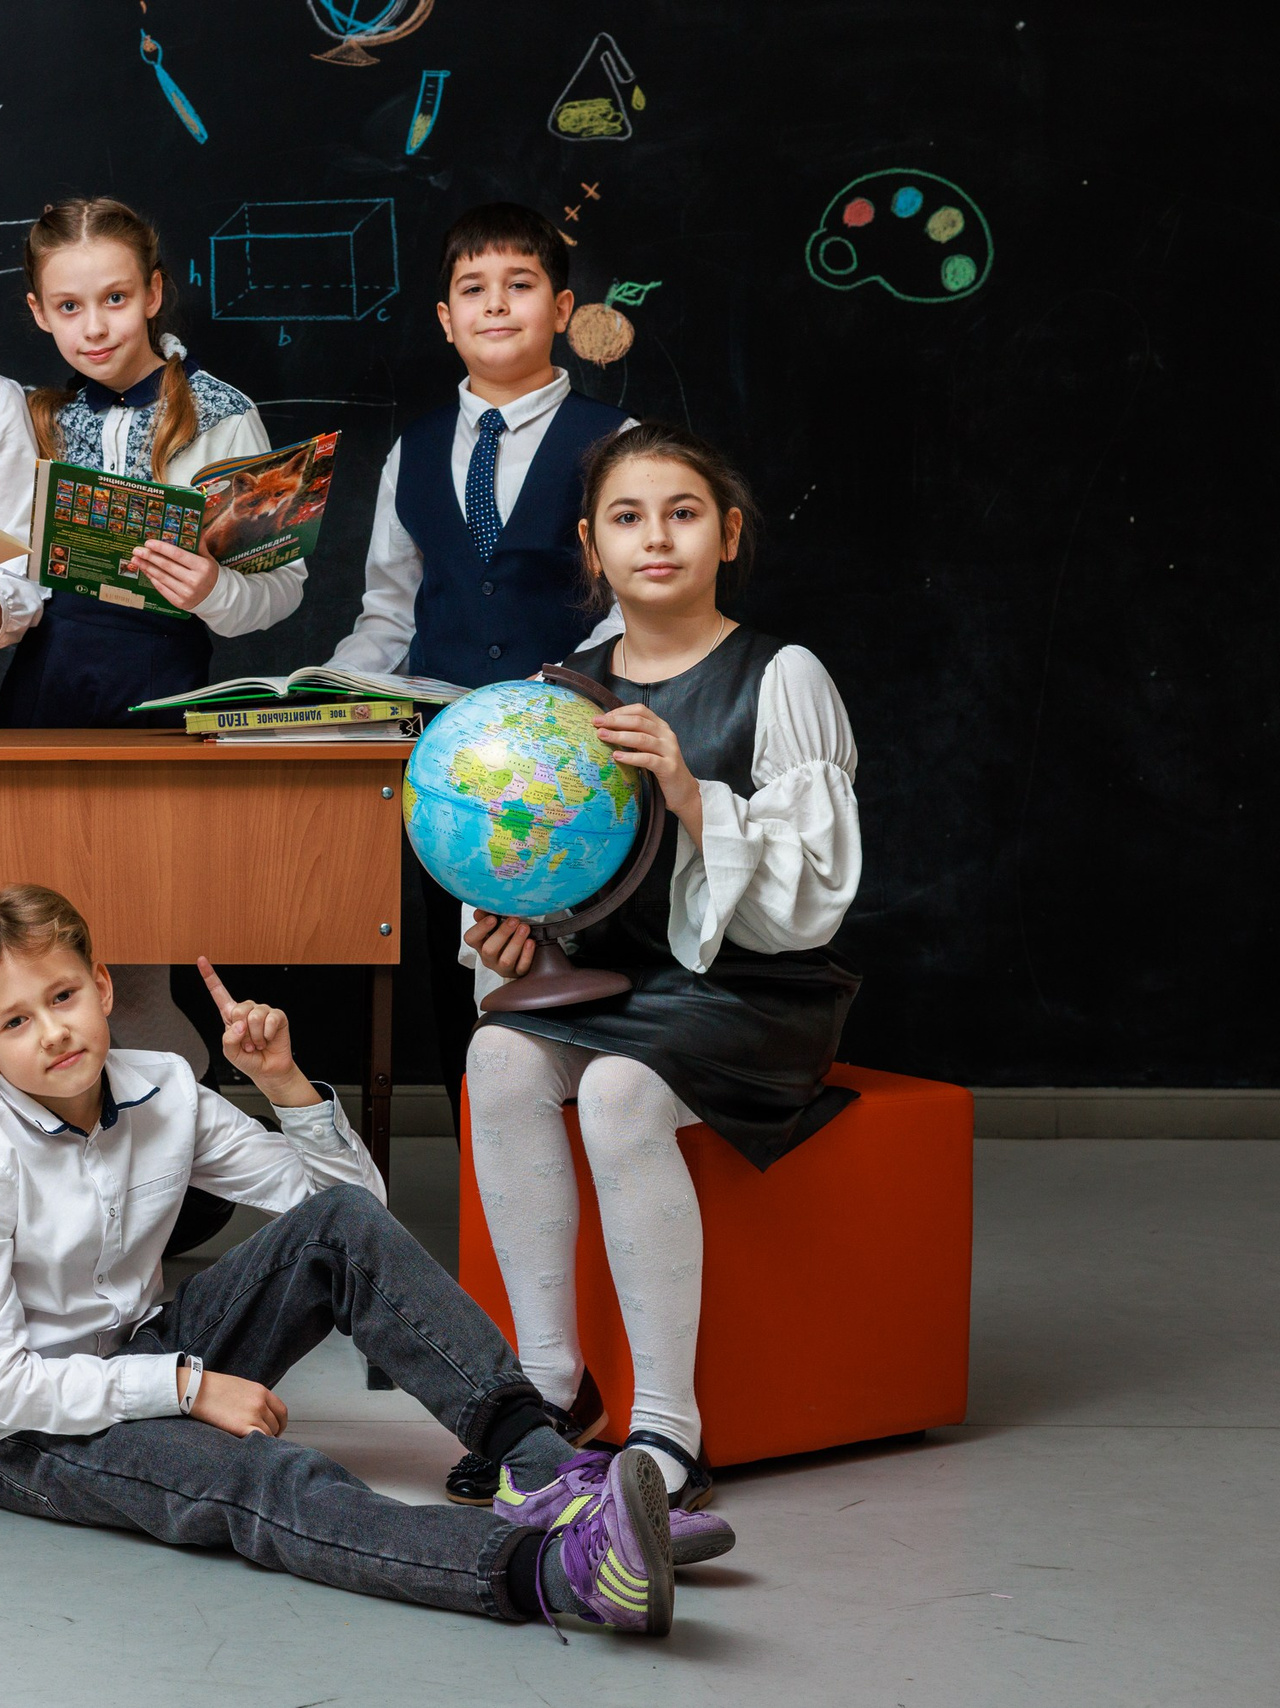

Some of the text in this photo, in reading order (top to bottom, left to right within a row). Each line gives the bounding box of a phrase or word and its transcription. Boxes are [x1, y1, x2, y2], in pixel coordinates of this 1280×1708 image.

[189, 259, 202, 287] h
[278, 326, 293, 347] b
[97, 475, 165, 495] ЭНЦИКЛОПЕДИЯ
[221, 534, 292, 566] ЭНЦИКЛОПЕДИЯ
[231, 549, 278, 572] ЕСНЫЕ
[218, 709, 347, 728] ТВОЕ УДИВИТЕЛЬНОЕ ТЕЛО
